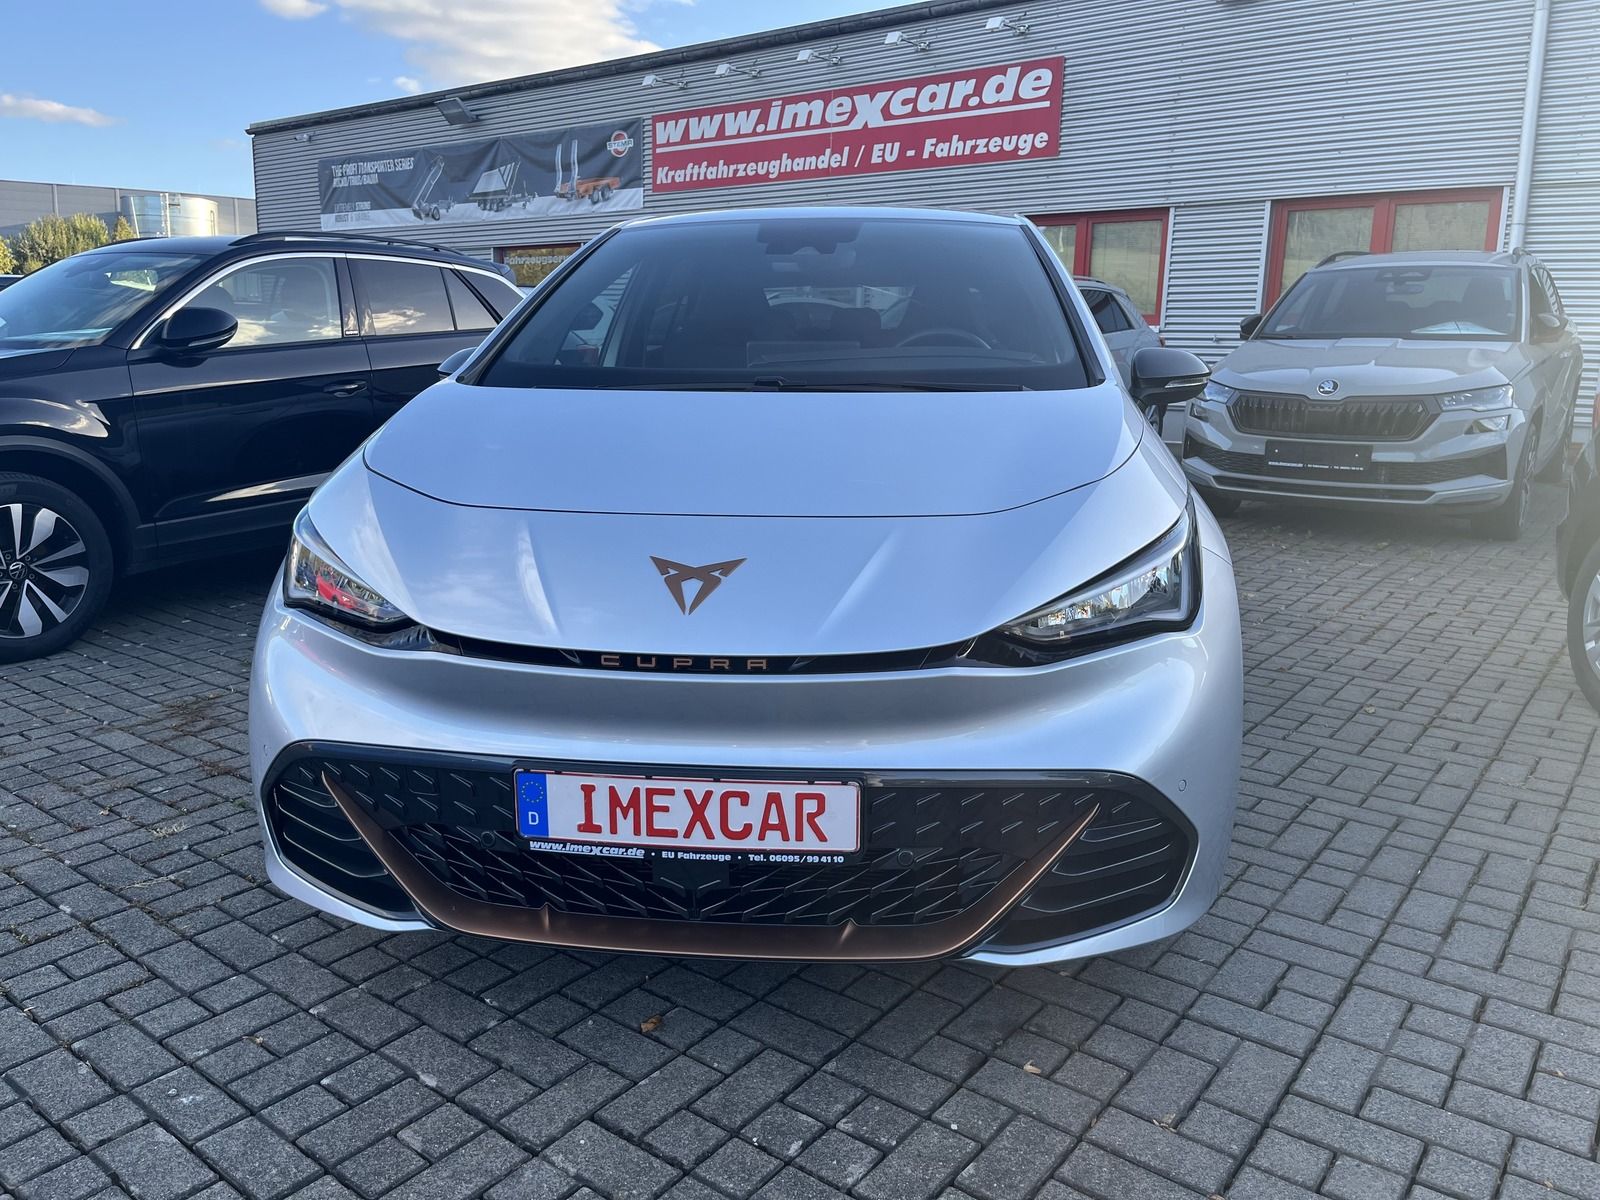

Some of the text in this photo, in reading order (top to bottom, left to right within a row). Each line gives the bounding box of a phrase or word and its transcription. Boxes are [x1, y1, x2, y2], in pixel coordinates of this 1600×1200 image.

[655, 66, 1053, 144] www.imexcar.de
[656, 146, 849, 185] Kraftfahrzeughandel
[871, 143, 900, 165] EU
[922, 130, 1049, 160] Fahrzeuge
[601, 655, 767, 670] CUPRA
[528, 811, 540, 825] D
[577, 783, 828, 843] IMEXCAR
[529, 841, 645, 858] www.imexcar.de
[662, 851, 675, 859] EU
[677, 852, 731, 861] Fahrzeuge
[748, 854, 767, 862] Tel.
